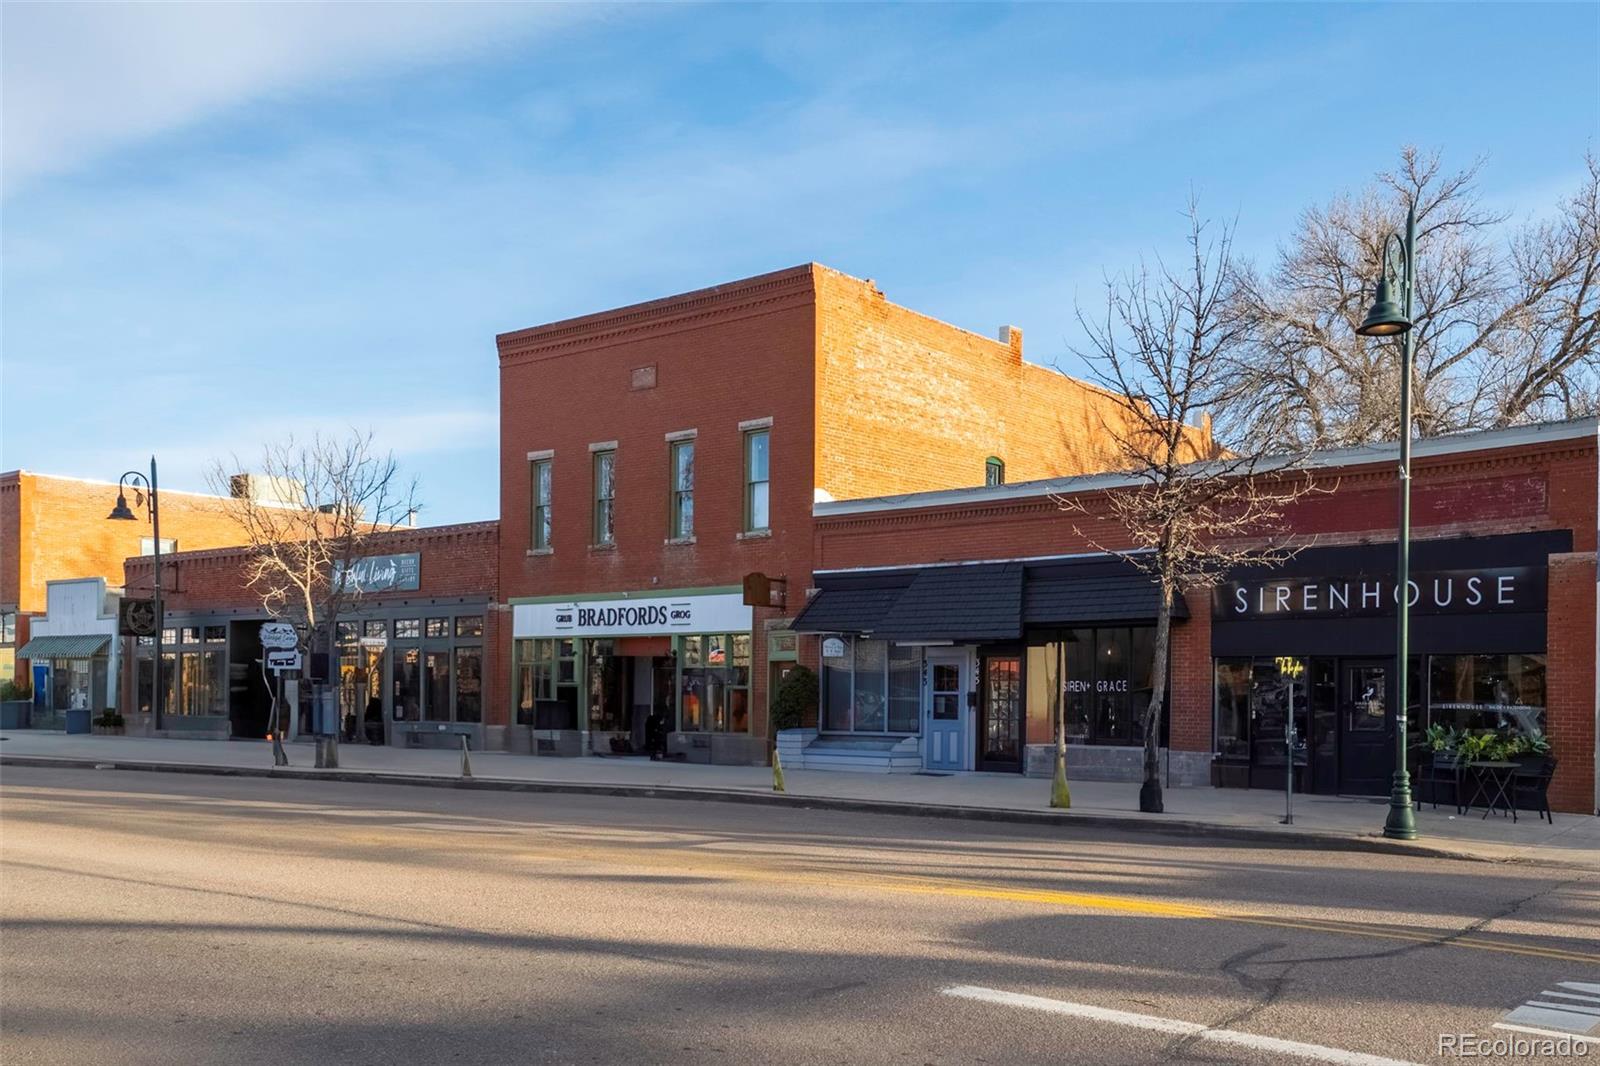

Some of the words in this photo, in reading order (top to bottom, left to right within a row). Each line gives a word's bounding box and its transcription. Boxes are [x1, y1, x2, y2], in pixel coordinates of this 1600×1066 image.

[1235, 576, 1514, 613] SIRENHOUSE
[555, 614, 573, 623] GRUB
[577, 605, 668, 626] BRADFORDS
[670, 610, 691, 620] GROG
[1096, 680, 1128, 693] GRACE
